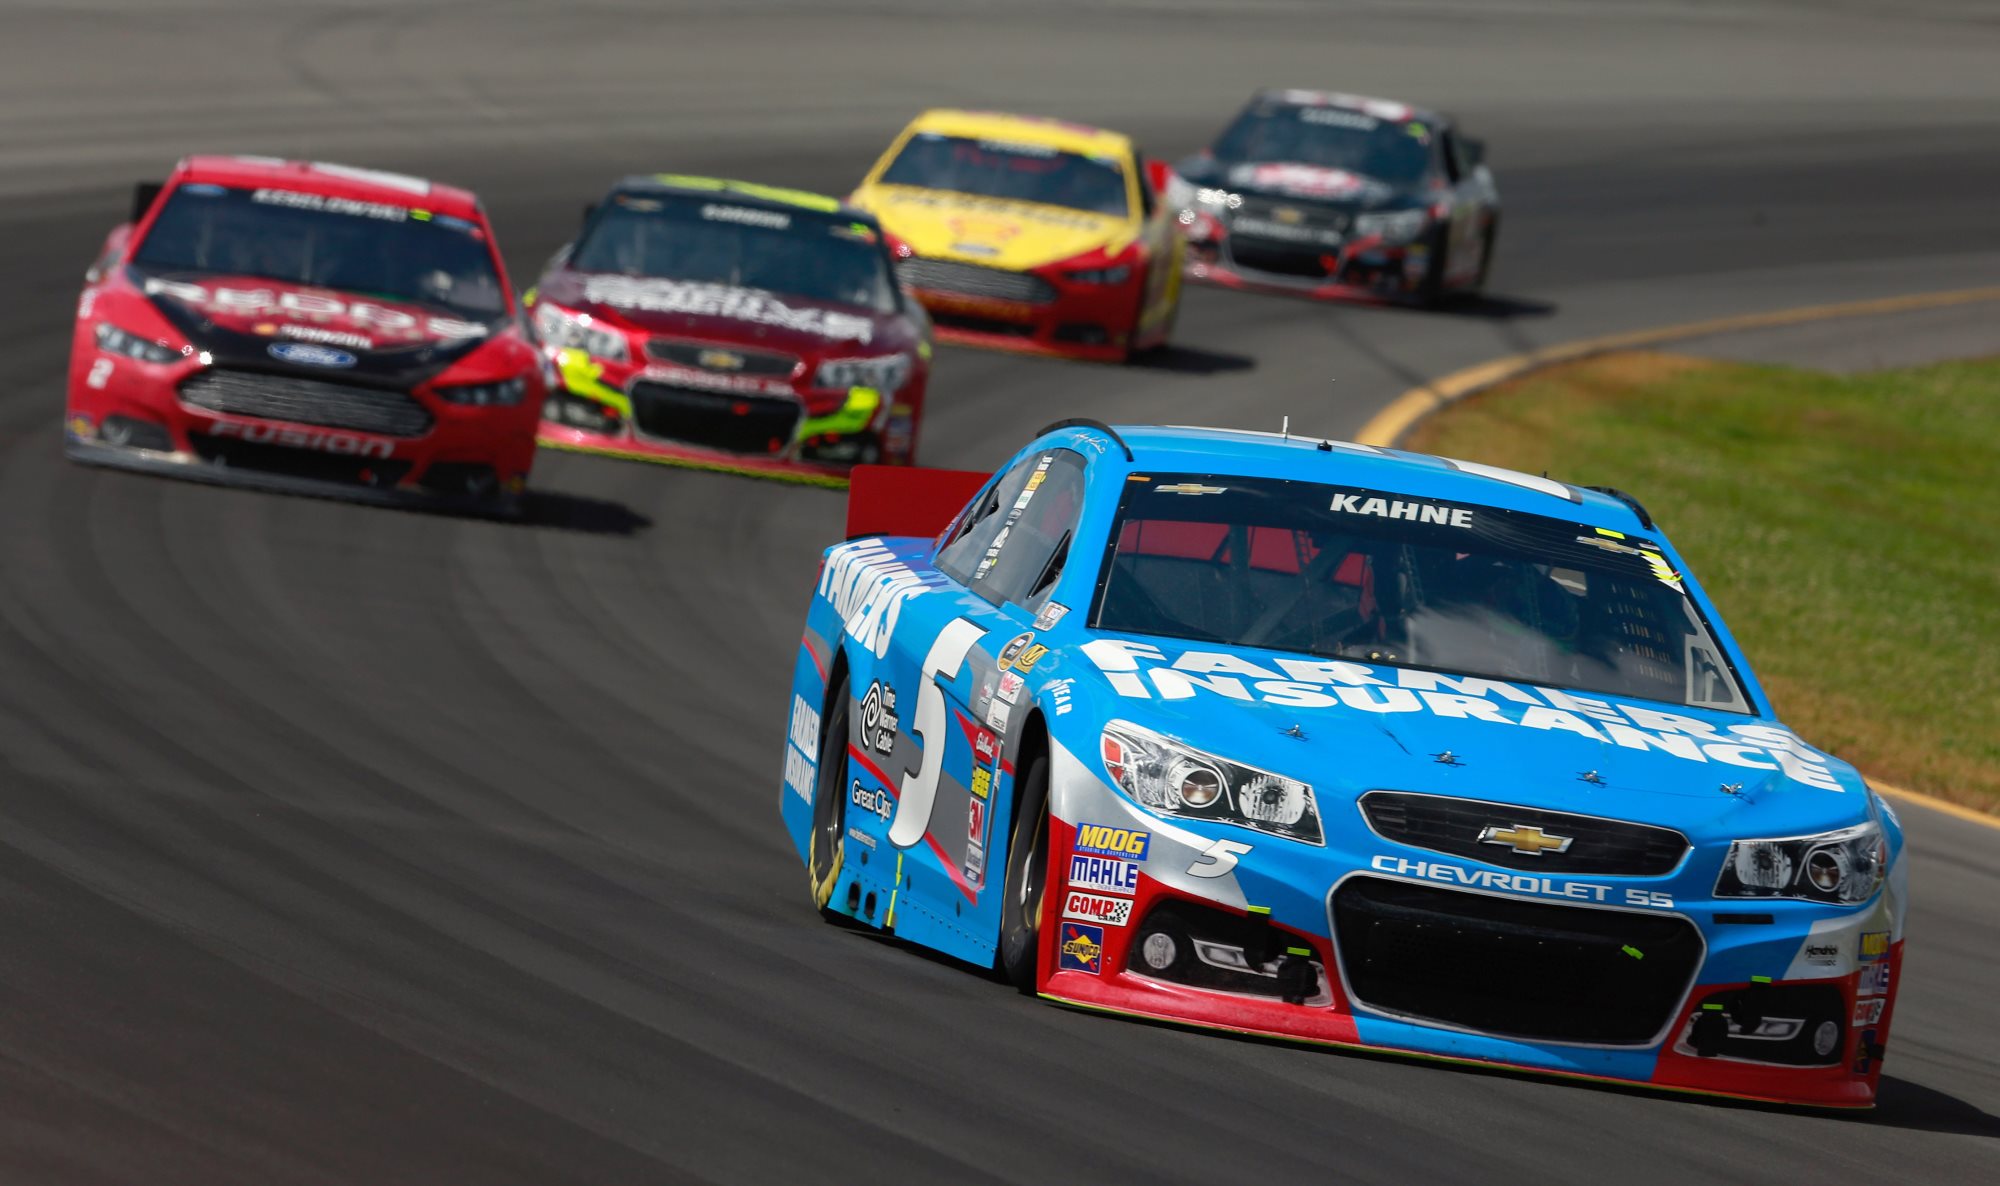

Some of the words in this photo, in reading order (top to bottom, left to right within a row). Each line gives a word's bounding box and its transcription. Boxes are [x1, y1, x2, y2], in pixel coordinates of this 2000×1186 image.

[208, 420, 396, 460] FUSION
[1329, 494, 1473, 528] KAHNE
[819, 538, 932, 660] FARMERS
[883, 685, 897, 710] Time
[1081, 640, 1825, 765] FARMERS
[879, 709, 899, 732] Warner
[888, 616, 990, 847] 5
[1104, 671, 1845, 793] INSURANCE
[875, 730, 893, 753] Cable
[852, 780, 874, 811] Great
[875, 790, 892, 823] Clips
[1077, 825, 1148, 854] MOOG
[1070, 856, 1138, 888] MAHLE
[1186, 839, 1253, 878] 5
[1371, 855, 1613, 901] CHEVROLET
[1625, 889, 1674, 908] SS
[1068, 895, 1115, 916] COMP
[1097, 914, 1122, 923] CAMS
[1065, 942, 1099, 957] SUNOCO
